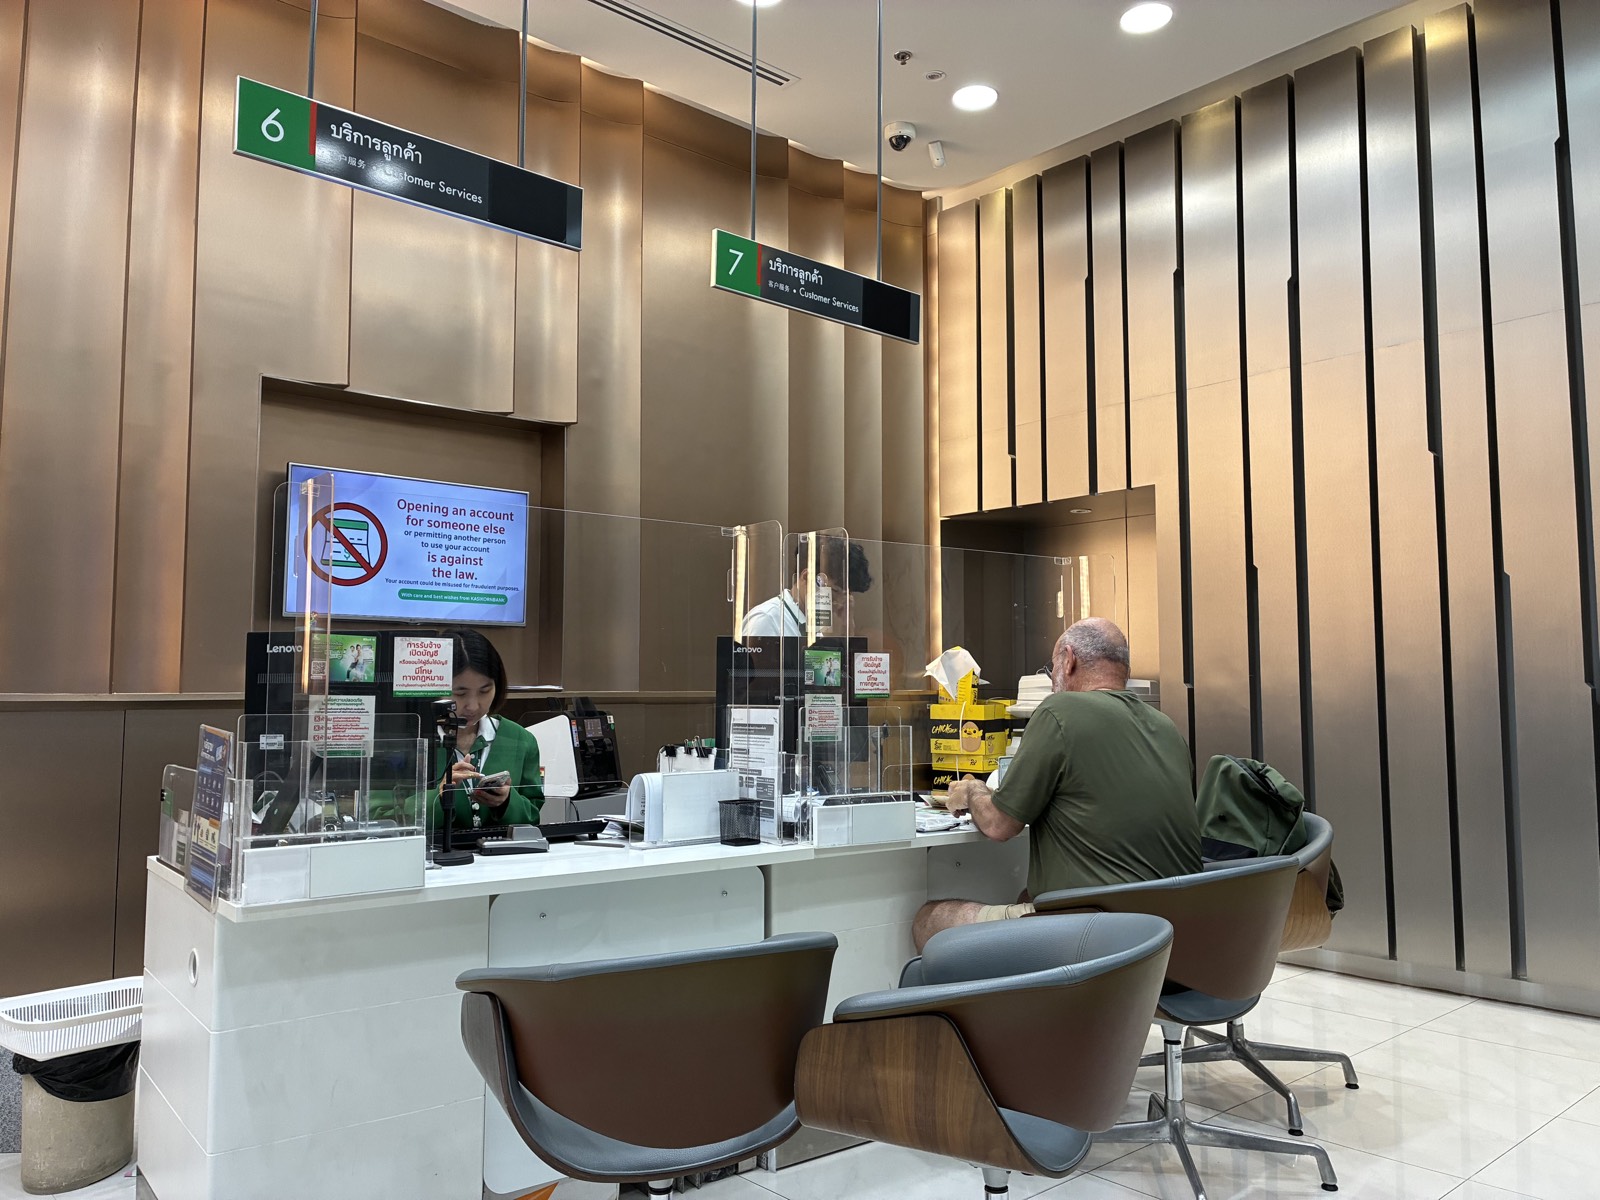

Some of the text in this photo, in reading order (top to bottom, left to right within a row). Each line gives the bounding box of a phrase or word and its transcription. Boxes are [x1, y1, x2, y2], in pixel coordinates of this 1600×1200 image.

[261, 107, 285, 142] 6
[330, 122, 422, 164] บริการลูกค้า
[438, 180, 483, 204] Services
[729, 248, 744, 276] 7
[768, 257, 823, 285] บริการลูกค้า
[799, 287, 859, 313] Customer Services
[397, 499, 514, 521] Opening an account
[406, 514, 505, 534] for someone else
[413, 530, 452, 541] permitting
[453, 534, 481, 542] another
[482, 537, 506, 545] person
[427, 552, 483, 566] is against
[462, 545, 490, 553] account
[432, 567, 478, 580] the law.
[266, 643, 303, 653] Lenovo
